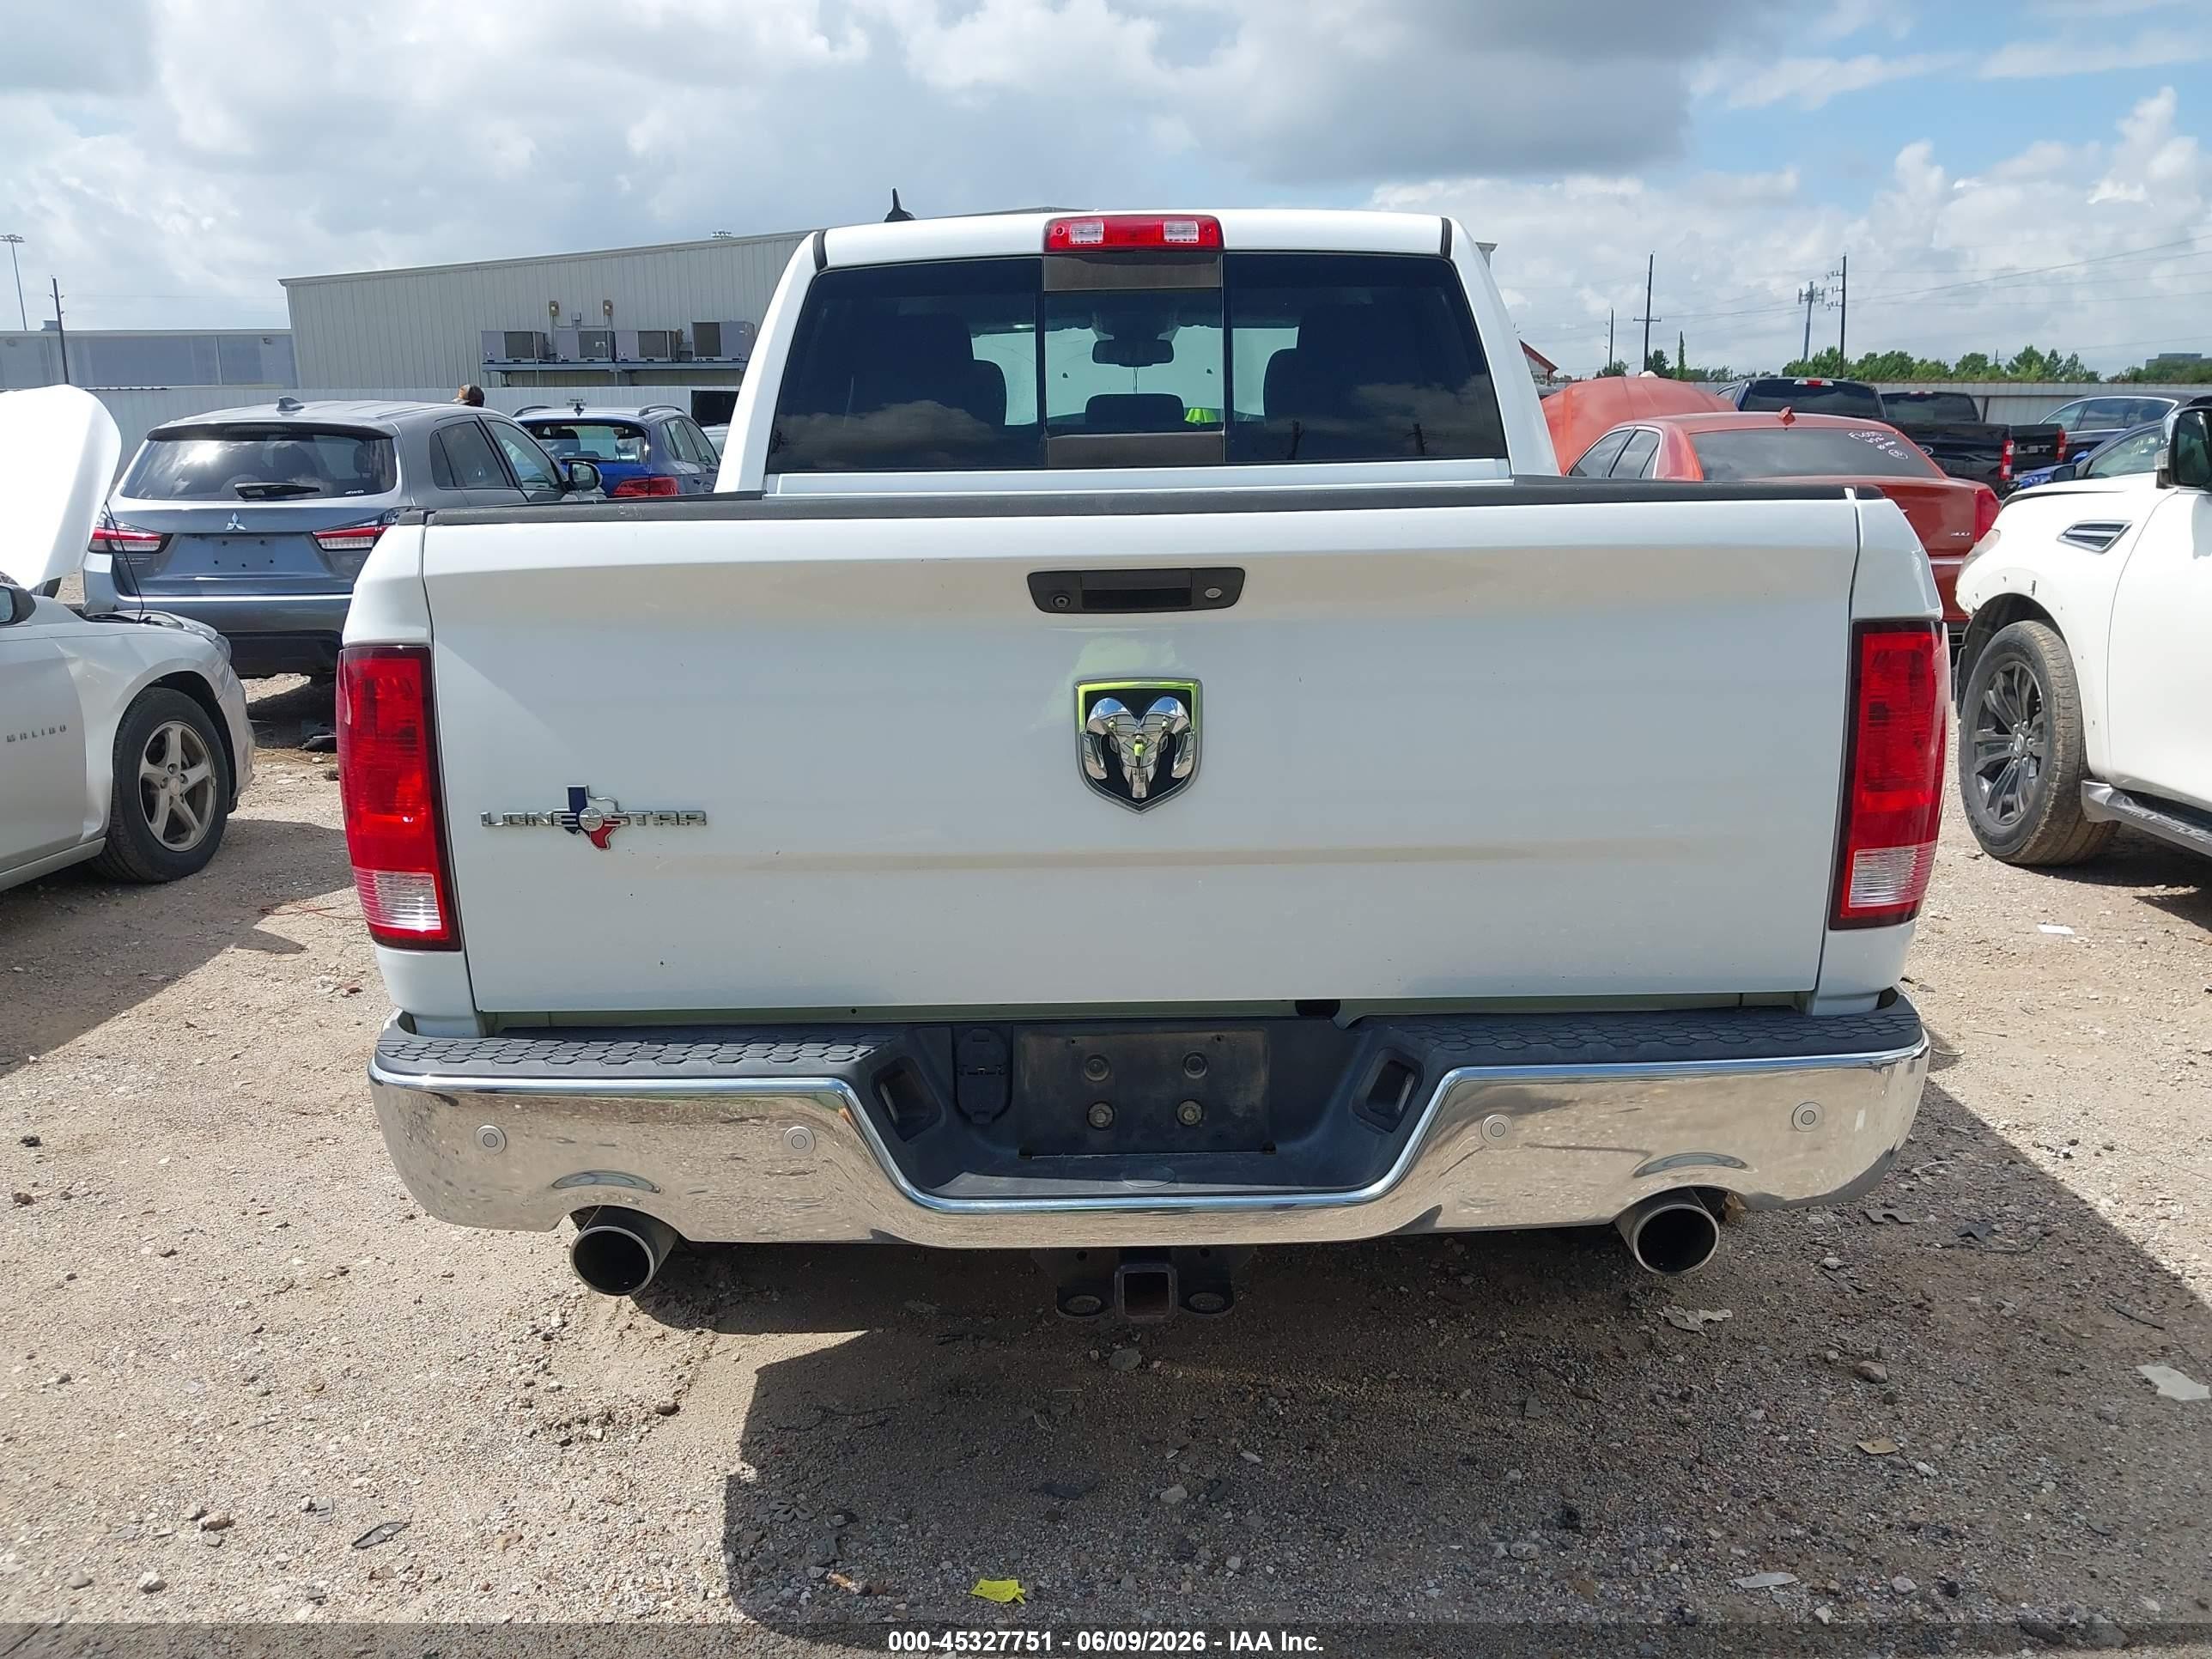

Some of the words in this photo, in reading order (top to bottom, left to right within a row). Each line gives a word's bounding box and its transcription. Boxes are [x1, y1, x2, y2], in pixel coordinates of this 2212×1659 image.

[7, 724, 67, 742] MALIBU
[480, 811, 578, 828] LONE
[604, 810, 707, 826] STAR
